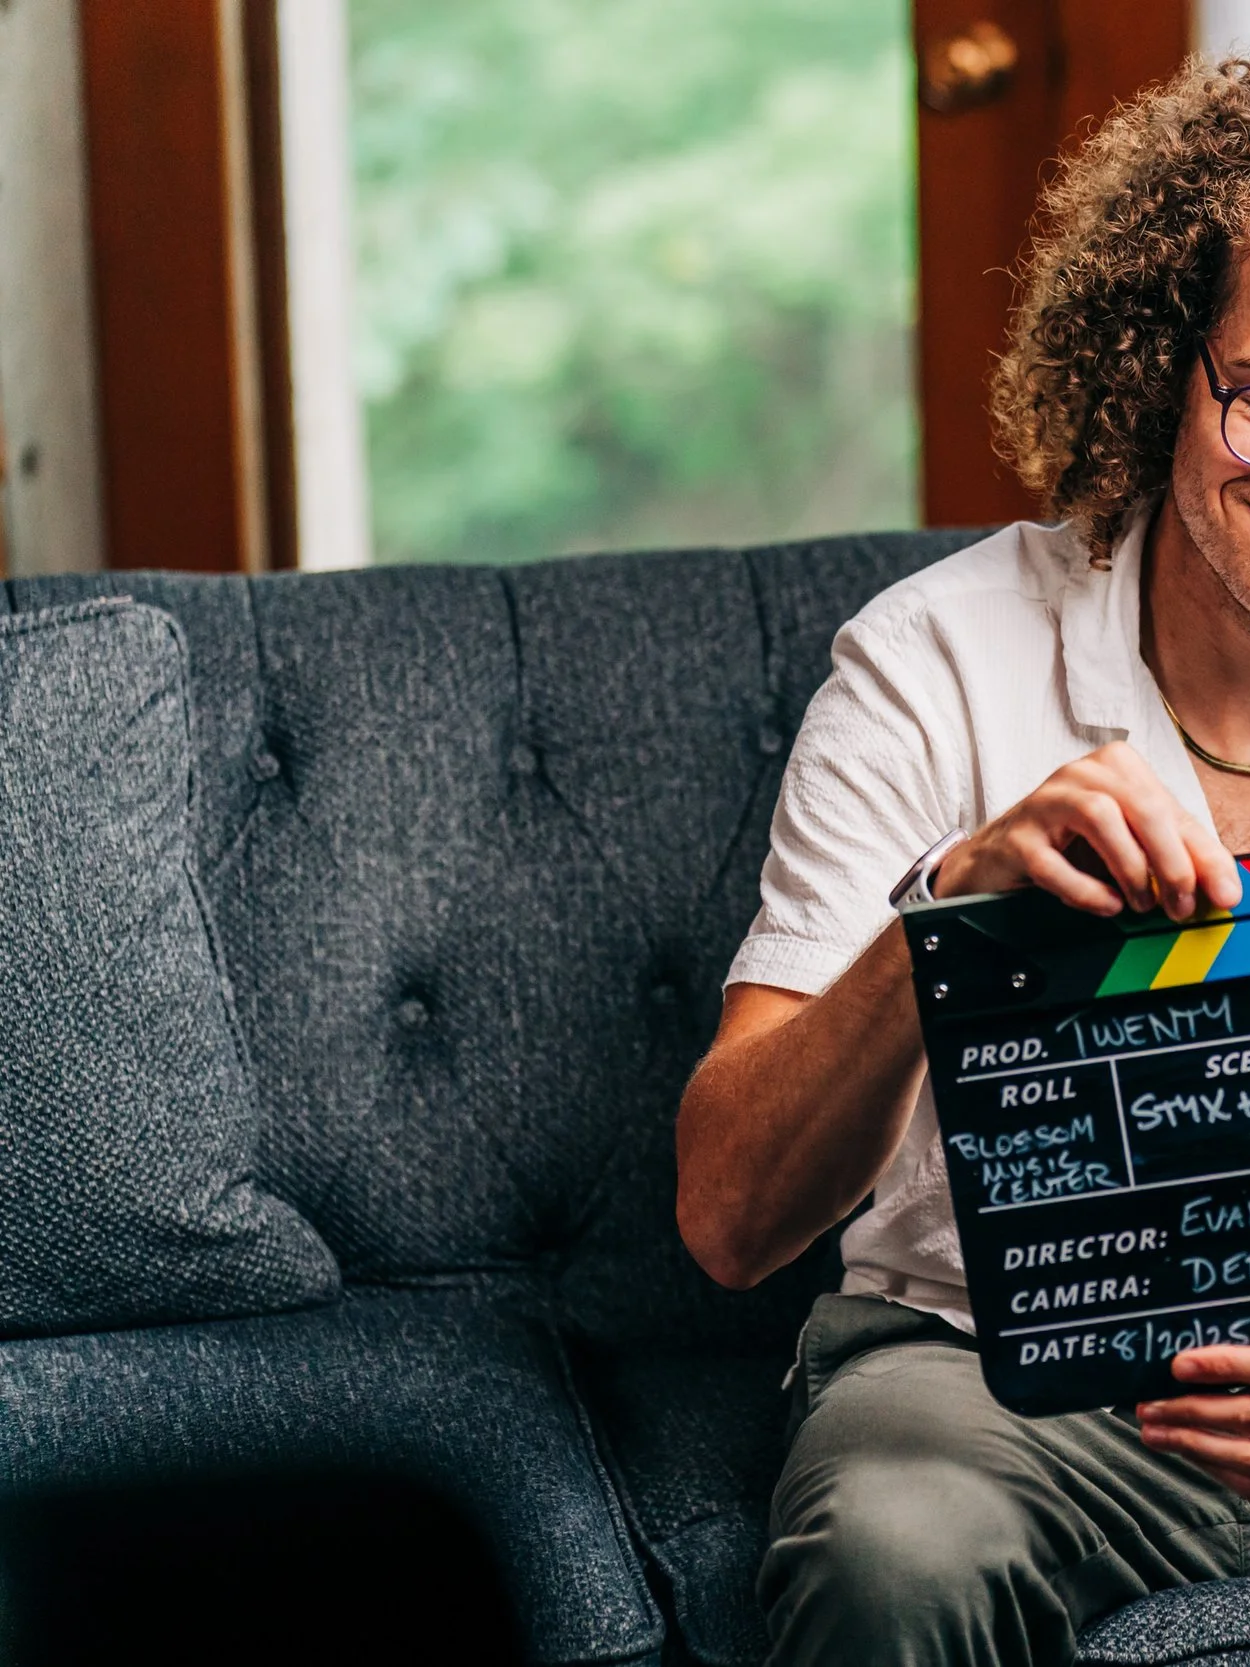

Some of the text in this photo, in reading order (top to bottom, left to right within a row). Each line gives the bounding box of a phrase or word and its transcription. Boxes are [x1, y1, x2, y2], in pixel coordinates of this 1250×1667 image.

[1055, 994, 1235, 1058] TWENTY
[962, 1037, 1048, 1070] PROD.
[1001, 1077, 1077, 1108] ROLL
[949, 1114, 1096, 1159] BLOSSOM
[981, 1150, 1082, 1186] MUSIC
[989, 1163, 1122, 1206] CENTER
[1004, 1228, 1168, 1271] DIRECTOR:
[1010, 1275, 1151, 1314] CAMERA:
[1020, 1333, 1107, 1366] DATE:
